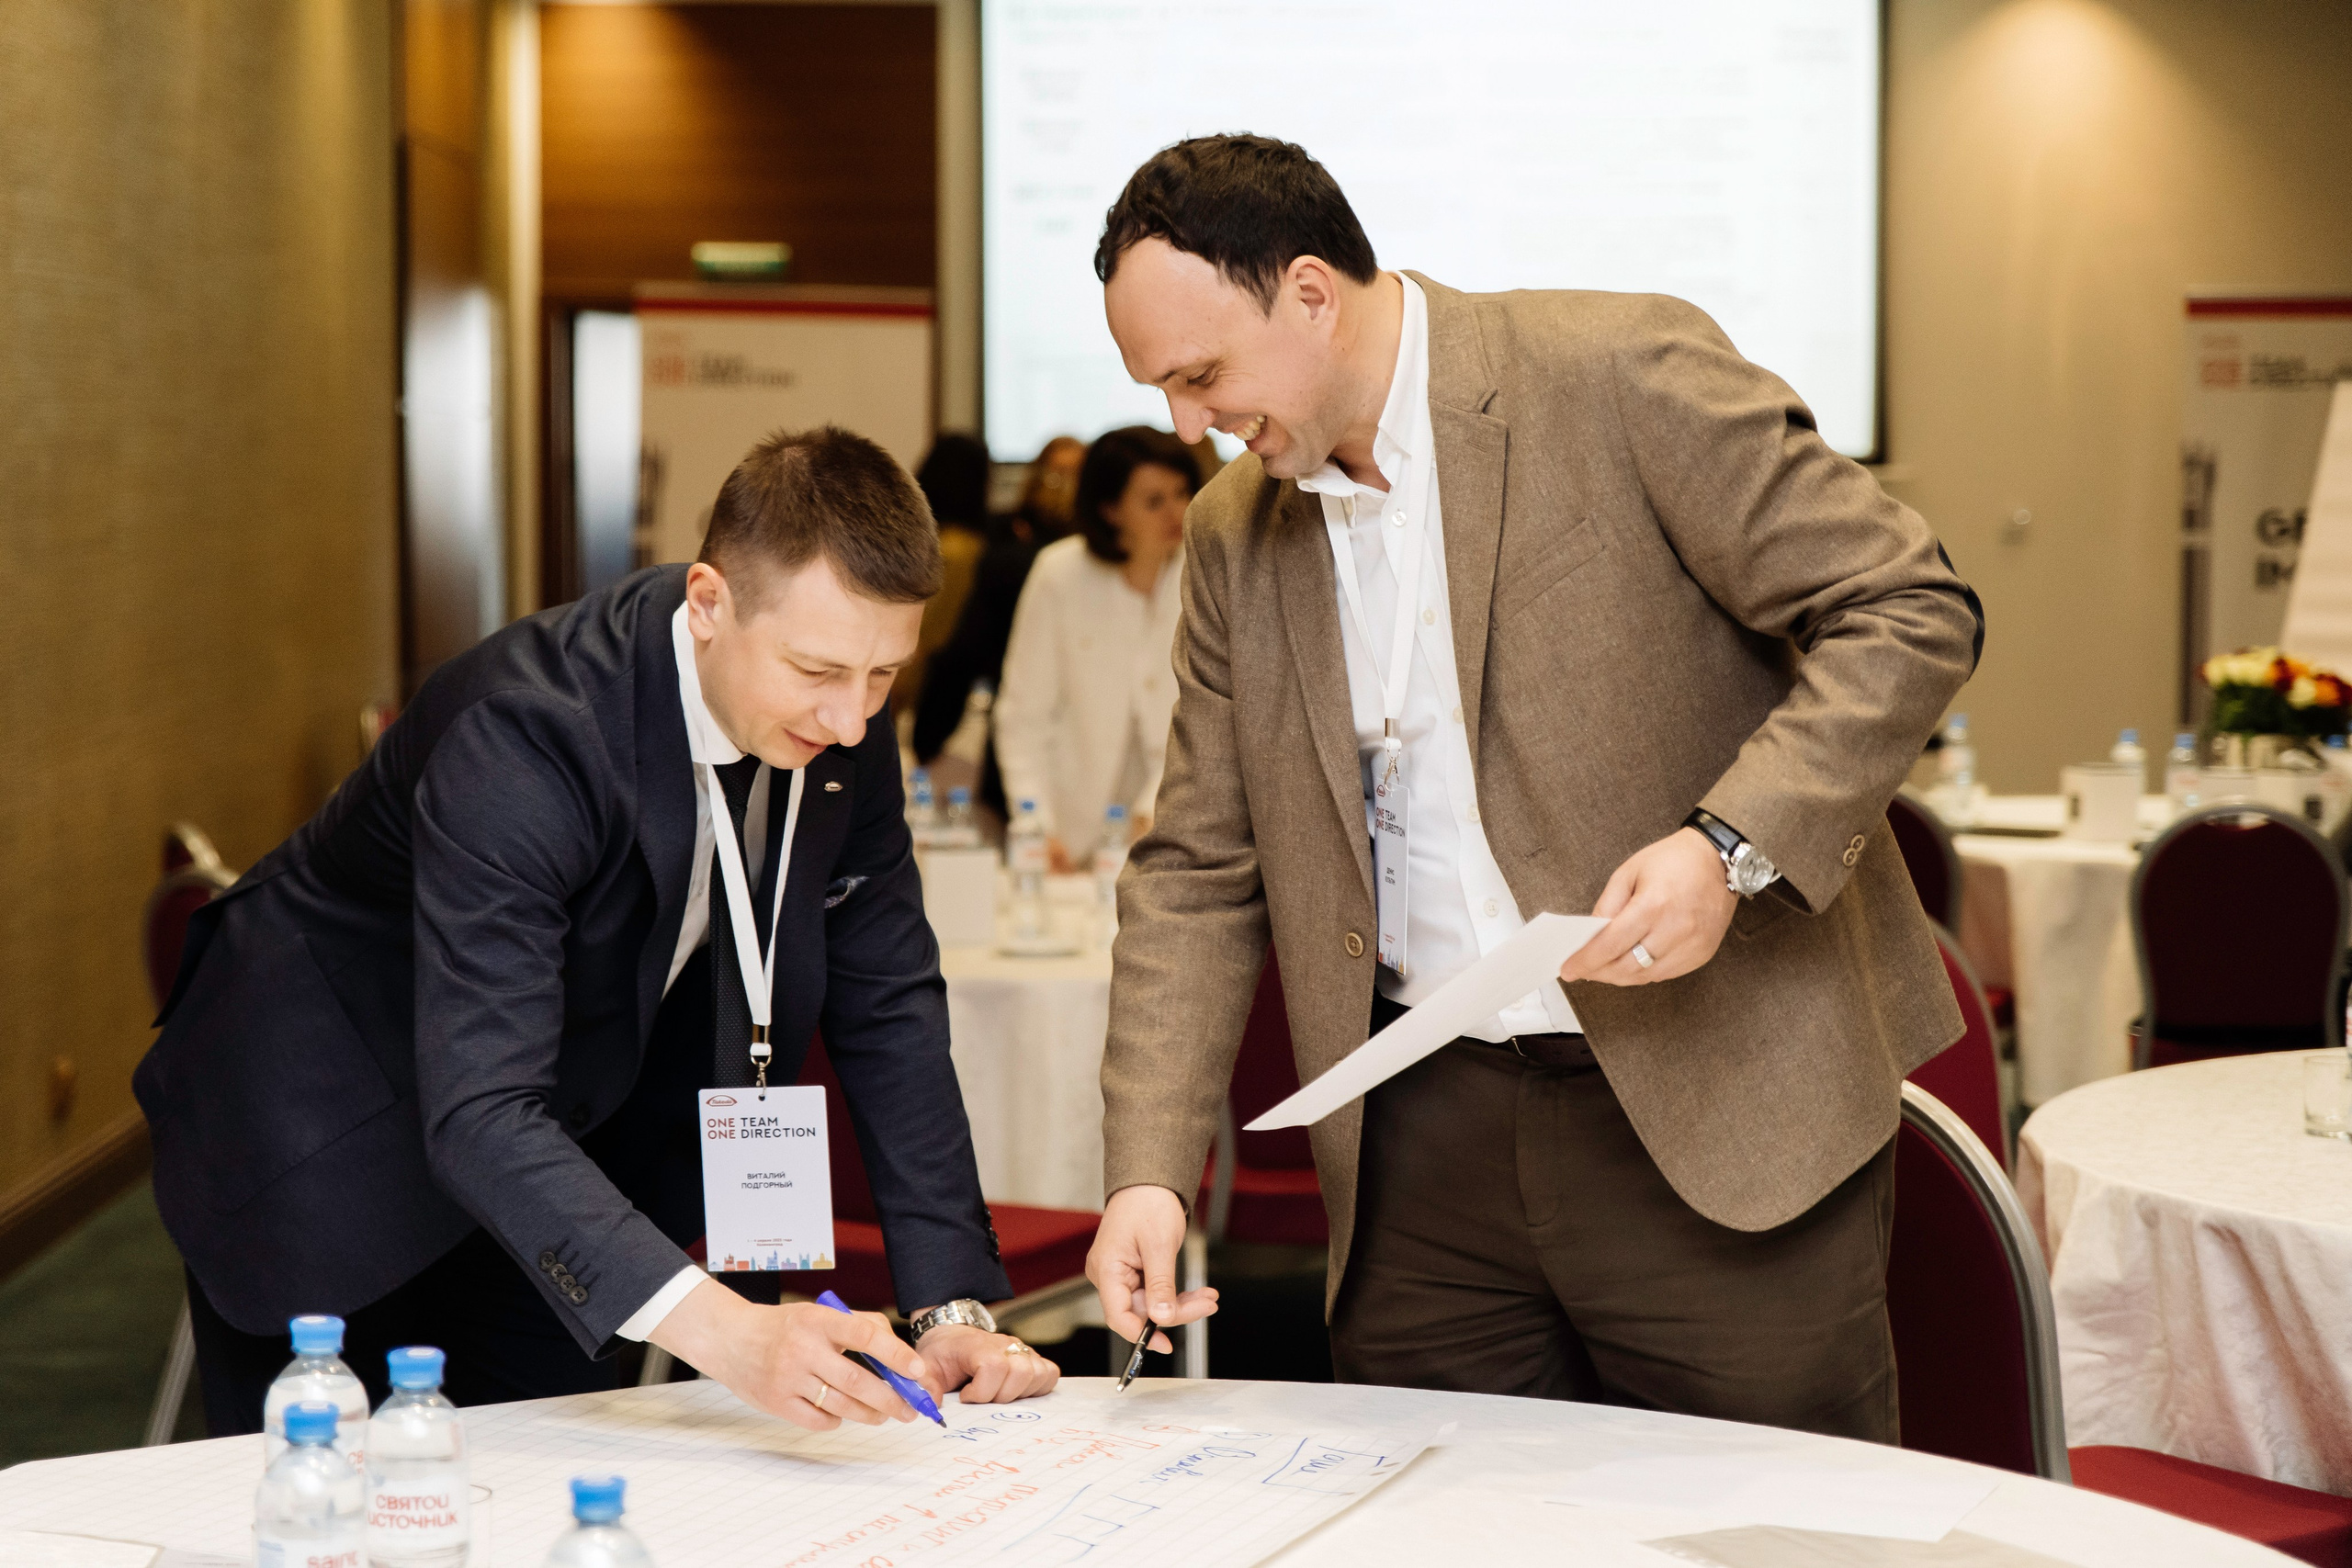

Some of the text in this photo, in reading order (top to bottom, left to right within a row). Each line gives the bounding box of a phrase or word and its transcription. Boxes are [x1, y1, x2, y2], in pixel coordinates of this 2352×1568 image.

[1376, 807, 1396, 823] ONE TEAM
[1376, 818, 1406, 838] ONE DIRECTION
[707, 1117, 778, 1128] ONE TEAM
[707, 1127, 816, 1140] ONE DIRECTION
[747, 1171, 786, 1179] ВИТАЛИЙ
[741, 1180, 793, 1190] ПОДГОРНЫЙ
